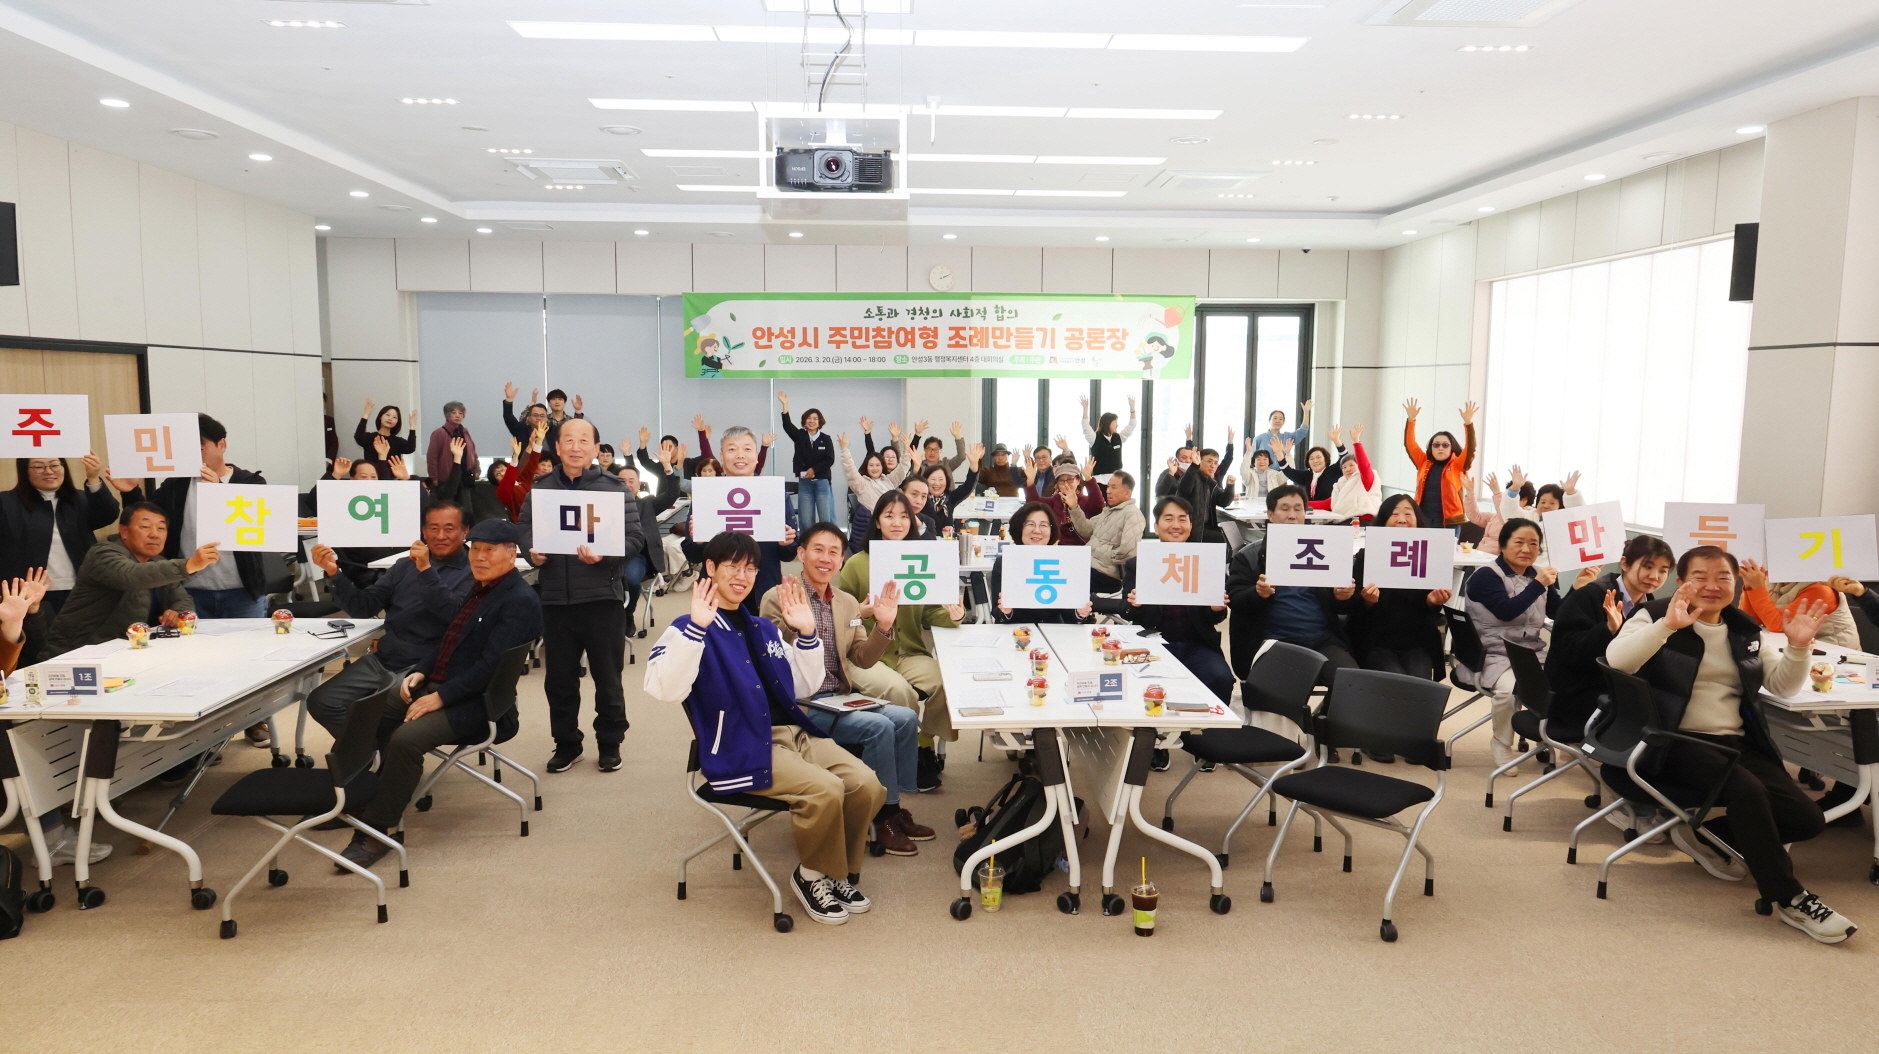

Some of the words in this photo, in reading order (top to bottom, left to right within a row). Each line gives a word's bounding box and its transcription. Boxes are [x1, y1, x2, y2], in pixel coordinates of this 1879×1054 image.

[863, 305, 900, 321] 소통과
[905, 306, 943, 321] 경청의
[949, 306, 988, 321] 사회적
[993, 304, 1019, 322] 합의
[752, 326, 820, 350] 안성시
[827, 326, 939, 350] 주민참여형
[947, 326, 1057, 350] 조례만들기
[1064, 327, 1130, 351] 공론장
[779, 355, 793, 363] 일시
[895, 355, 908, 363] 장소
[911, 355, 933, 363] 안성3동
[934, 355, 968, 363] 행정복지센터
[969, 355, 980, 364] 4층
[981, 355, 1004, 364] 대회의실
[12, 408, 61, 447] 주
[134, 425, 175, 472] 민
[225, 495, 271, 545] 참
[348, 493, 389, 534] 여
[559, 497, 601, 543] 마
[717, 487, 761, 536] 을
[1290, 538, 1330, 571] 조
[1390, 539, 1428, 578] 례
[1568, 515, 1605, 563] 만
[1798, 527, 1843, 569] 기
[893, 554, 936, 602] 공
[1025, 558, 1068, 605] 동
[1160, 553, 1199, 594] 체
[78, 673, 92, 681] 1조
[1104, 678, 1118, 687] 2조
